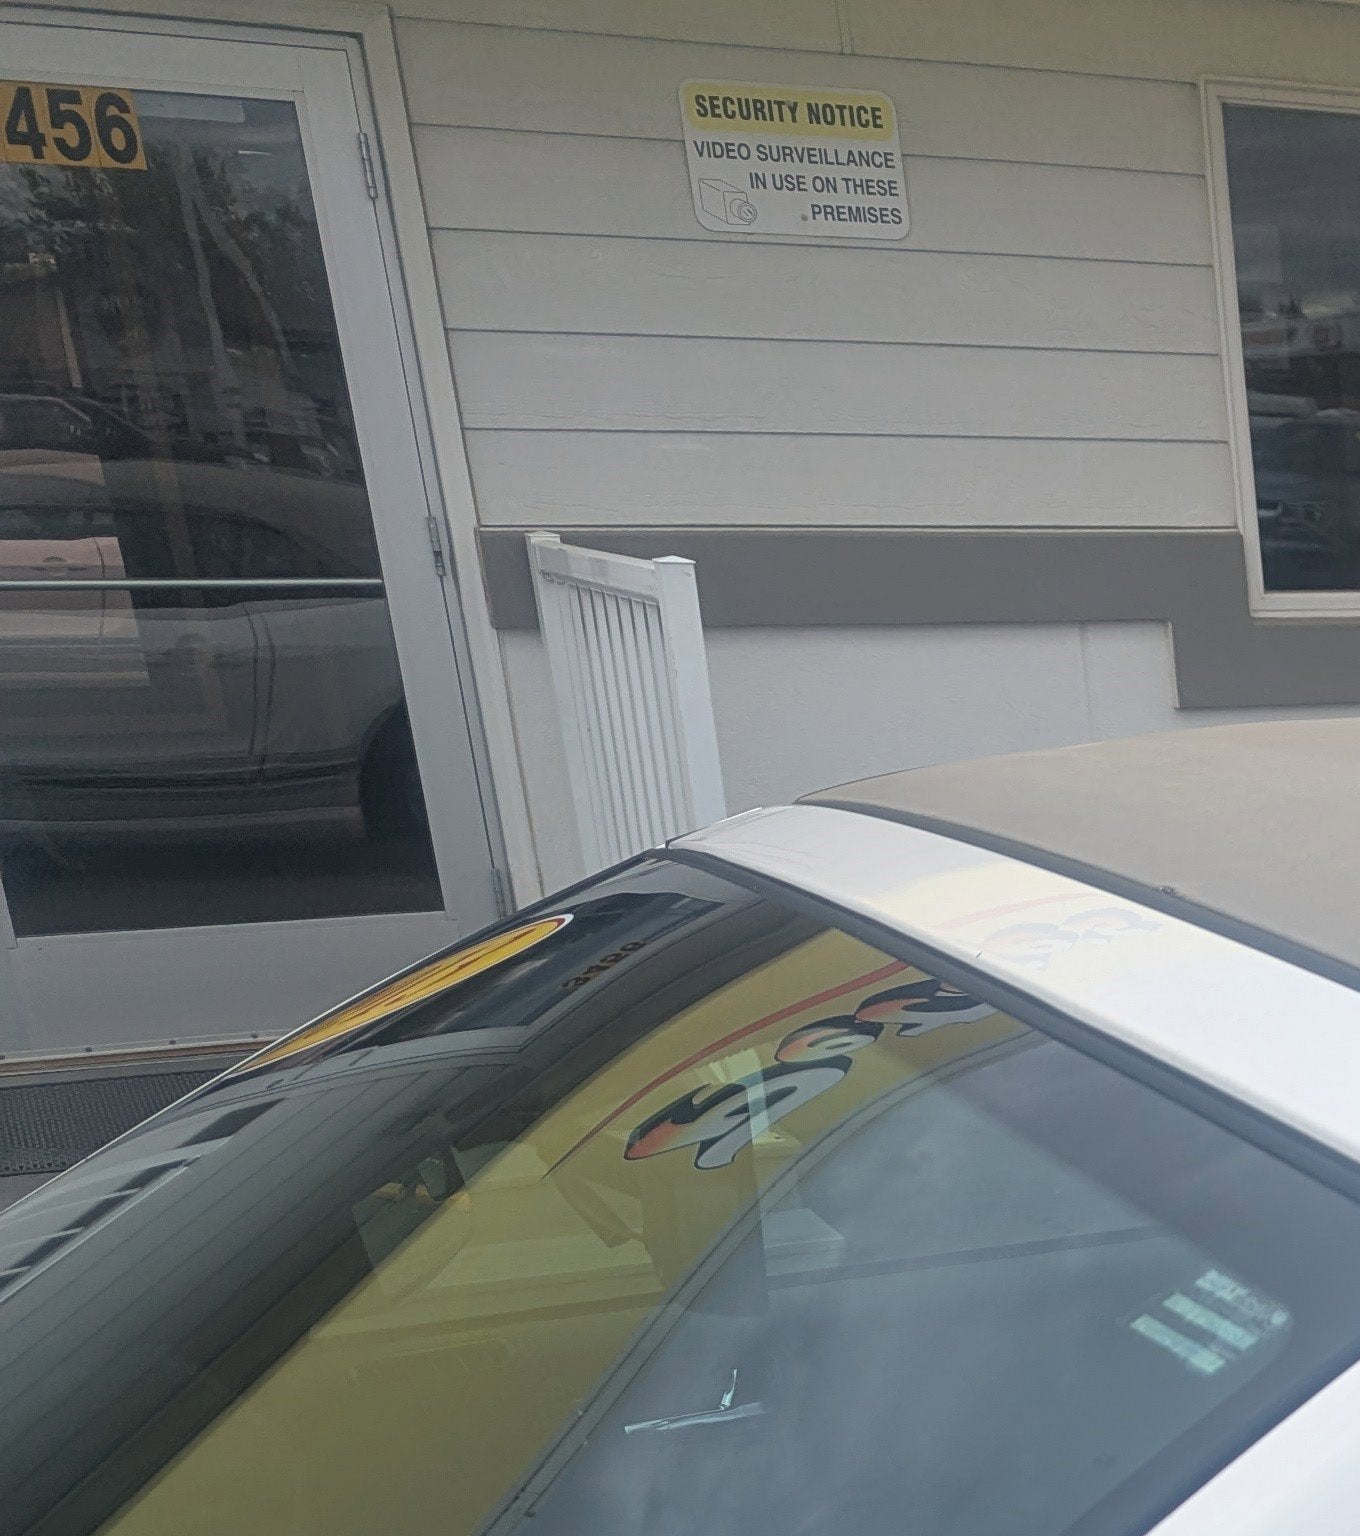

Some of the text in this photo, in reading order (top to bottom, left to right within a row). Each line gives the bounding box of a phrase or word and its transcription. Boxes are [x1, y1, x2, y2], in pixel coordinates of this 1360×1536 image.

[5, 86, 138, 164] 456
[694, 94, 884, 129] SECURITY NOTICE
[693, 140, 896, 169] VIDEO SURVEILLANCE
[749, 172, 899, 197] IN USE ON THESE
[811, 204, 903, 225] PREMISES
